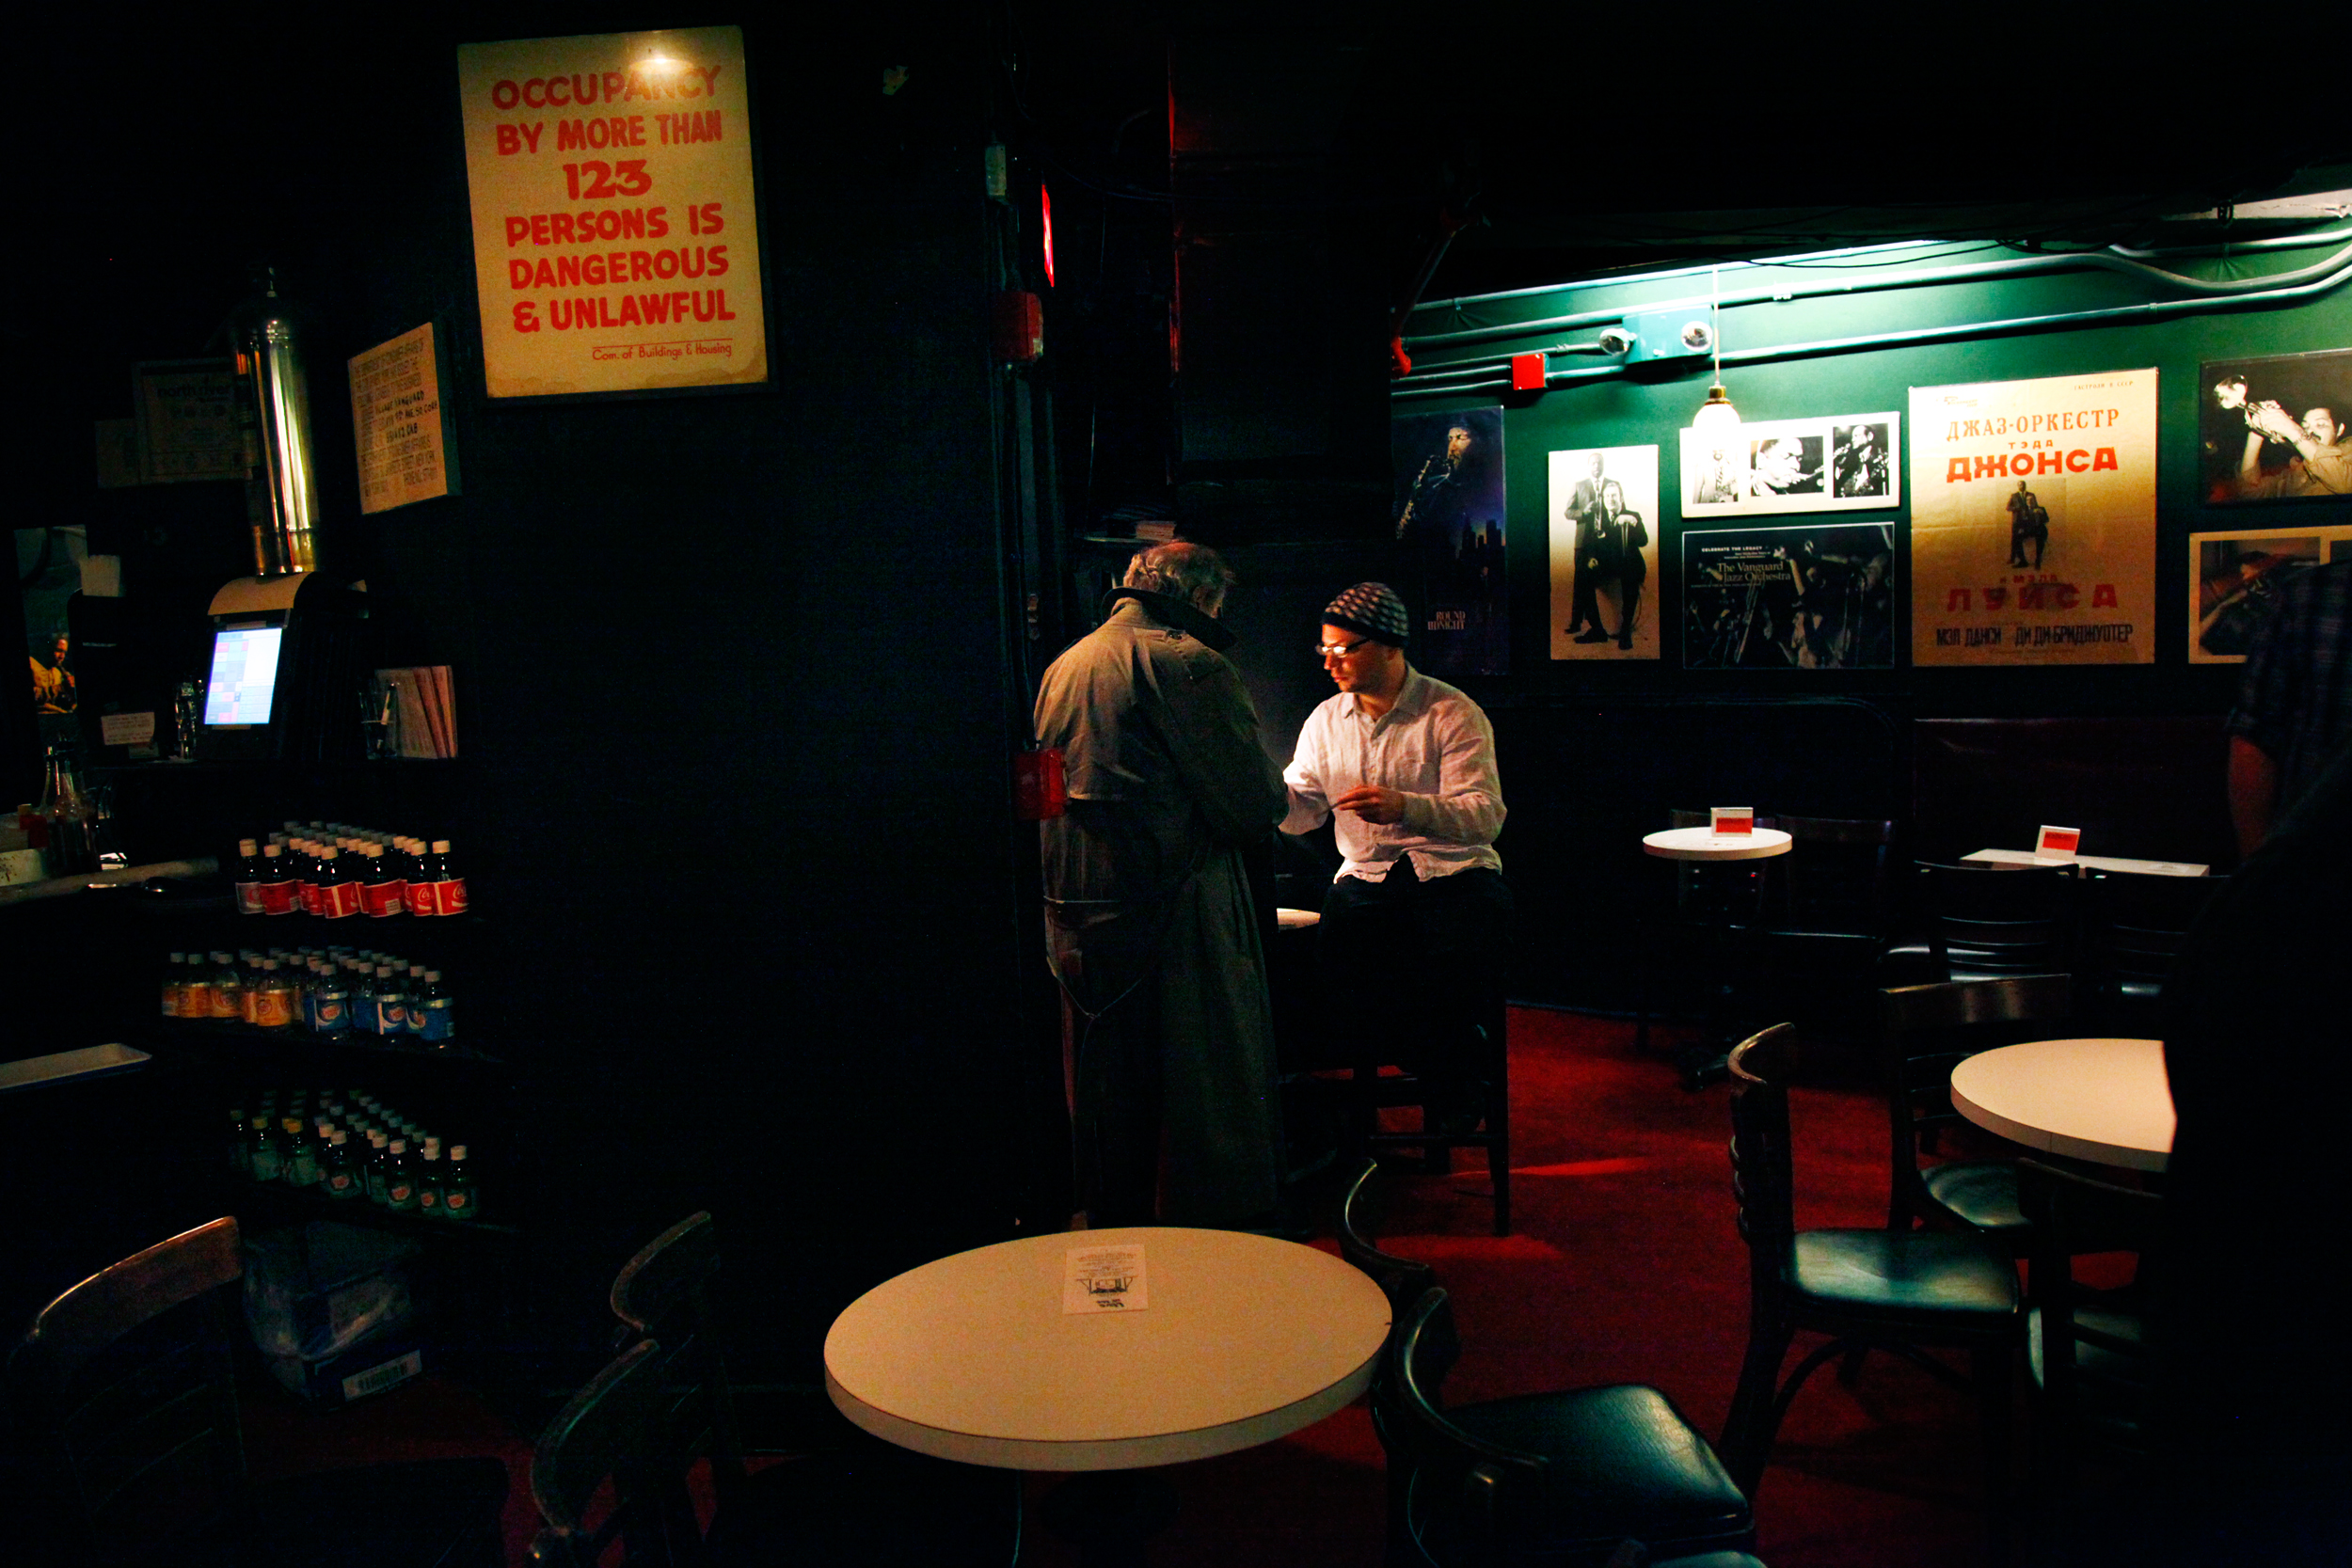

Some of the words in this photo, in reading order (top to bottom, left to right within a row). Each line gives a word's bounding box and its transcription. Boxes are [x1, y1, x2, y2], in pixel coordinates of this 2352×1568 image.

[491, 65, 722, 110] OCCUPANCY
[496, 122, 544, 155] BY
[557, 115, 646, 151] MORE
[656, 110, 723, 145] THAN
[563, 159, 652, 200] 123
[505, 206, 669, 247] PERSONS
[689, 202, 724, 236] IS
[509, 245, 729, 290] DANGEROUS
[513, 301, 540, 333] &
[549, 289, 736, 331] UNLAWFUL
[592, 349, 620, 361] Com.
[622, 346, 633, 359] of
[639, 343, 683, 361] Buildings
[686, 343, 692, 355] &
[695, 342, 732, 358] Housing
[1947, 408, 2119, 441] ДЖАЗ-ОРКЕСТР
[2008, 439, 2054, 450] ТЭДА
[1947, 447, 2118, 483] ДЖОНСА
[1717, 562, 1736, 573] The
[1737, 561, 1784, 573] Vanguard
[1723, 572, 1743, 583] Jazz
[1744, 571, 1791, 582] Orchestra
[1947, 583, 2118, 611] ЛУИСА
[1964, 627, 2001, 647] ДАНСИ
[2015, 626, 2031, 647] ДИ
[2033, 626, 2051, 646] ДИ
[2053, 624, 2133, 646] БРИДЖУОТЕР
